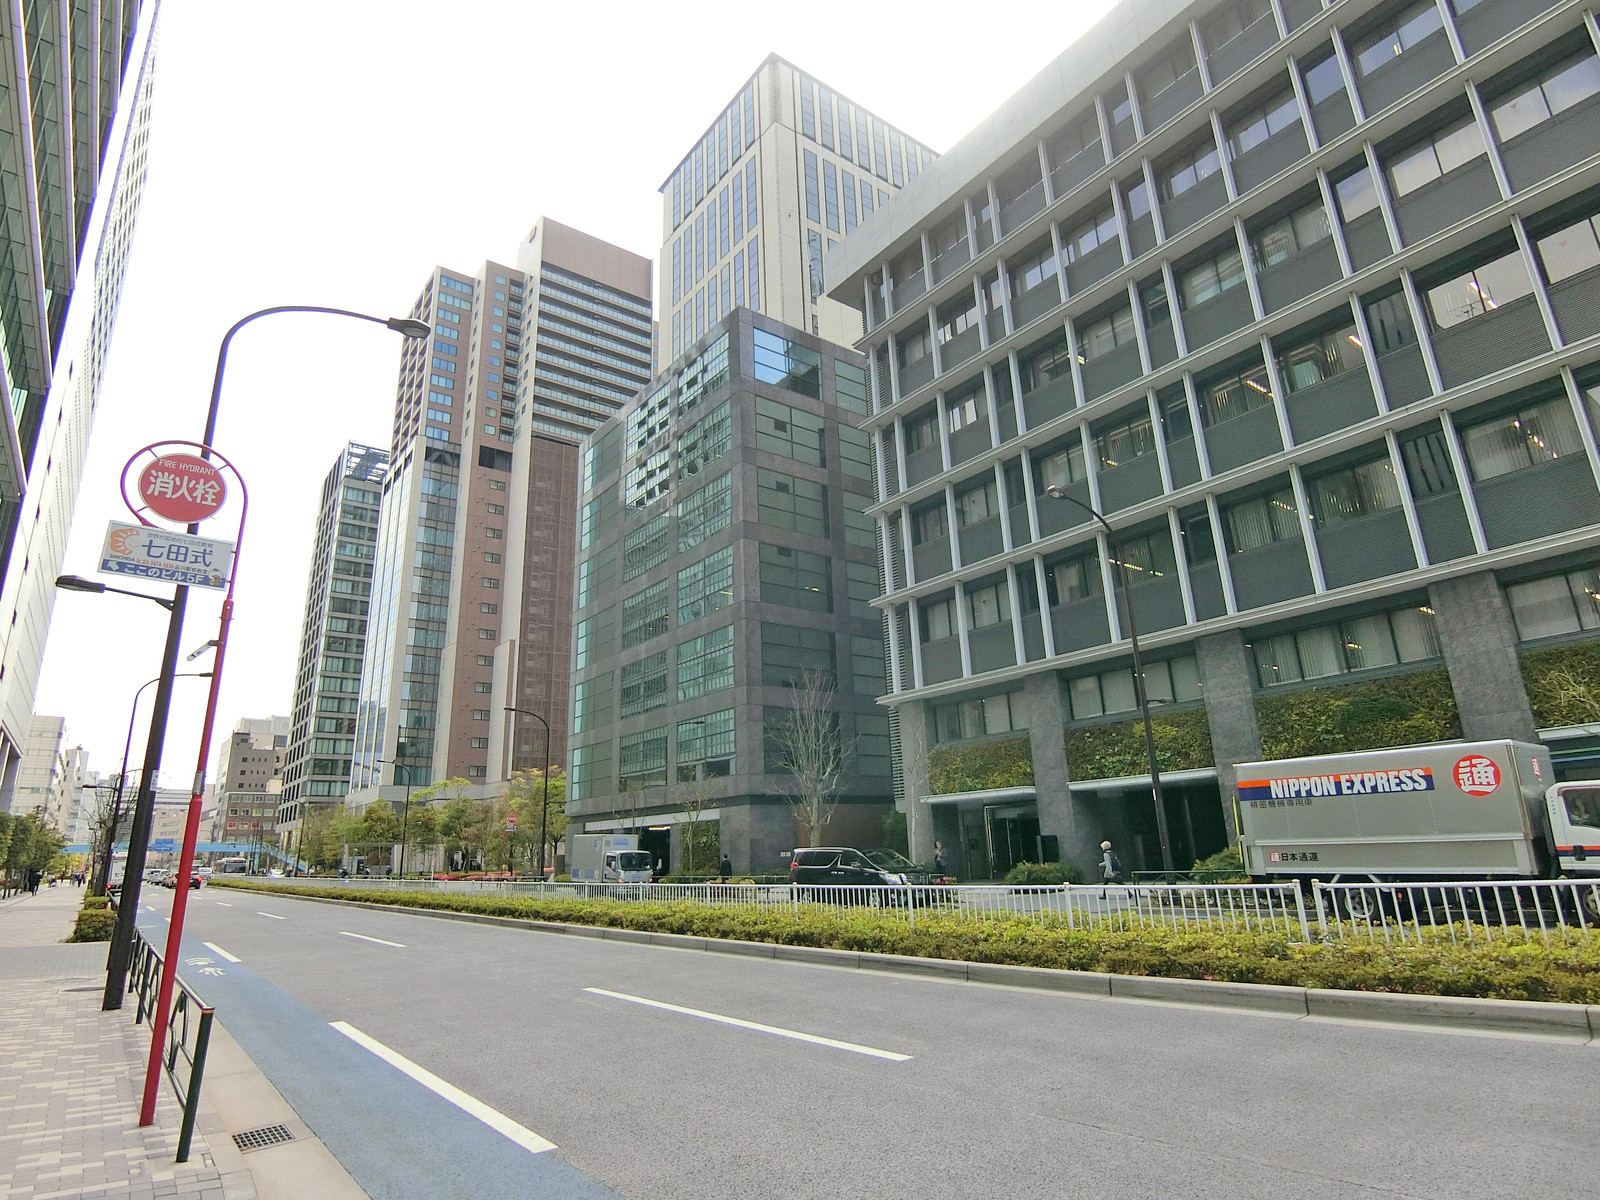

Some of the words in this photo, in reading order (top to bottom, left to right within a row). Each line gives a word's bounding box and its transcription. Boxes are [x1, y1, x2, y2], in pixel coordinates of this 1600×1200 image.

[159, 459, 177, 468] FIRE
[179, 462, 216, 476] HYDRANT
[146, 469, 221, 506] 消火栓
[109, 553, 135, 563] SHICHIDA
[142, 539, 214, 567] 七田式
[124, 564, 205, 584] ここのビル5F
[1269, 775, 1337, 799] NIPPON
[1340, 768, 1427, 796] EXPRESS
[1458, 758, 1498, 792] 通
[1281, 851, 1319, 862] 日本通運
